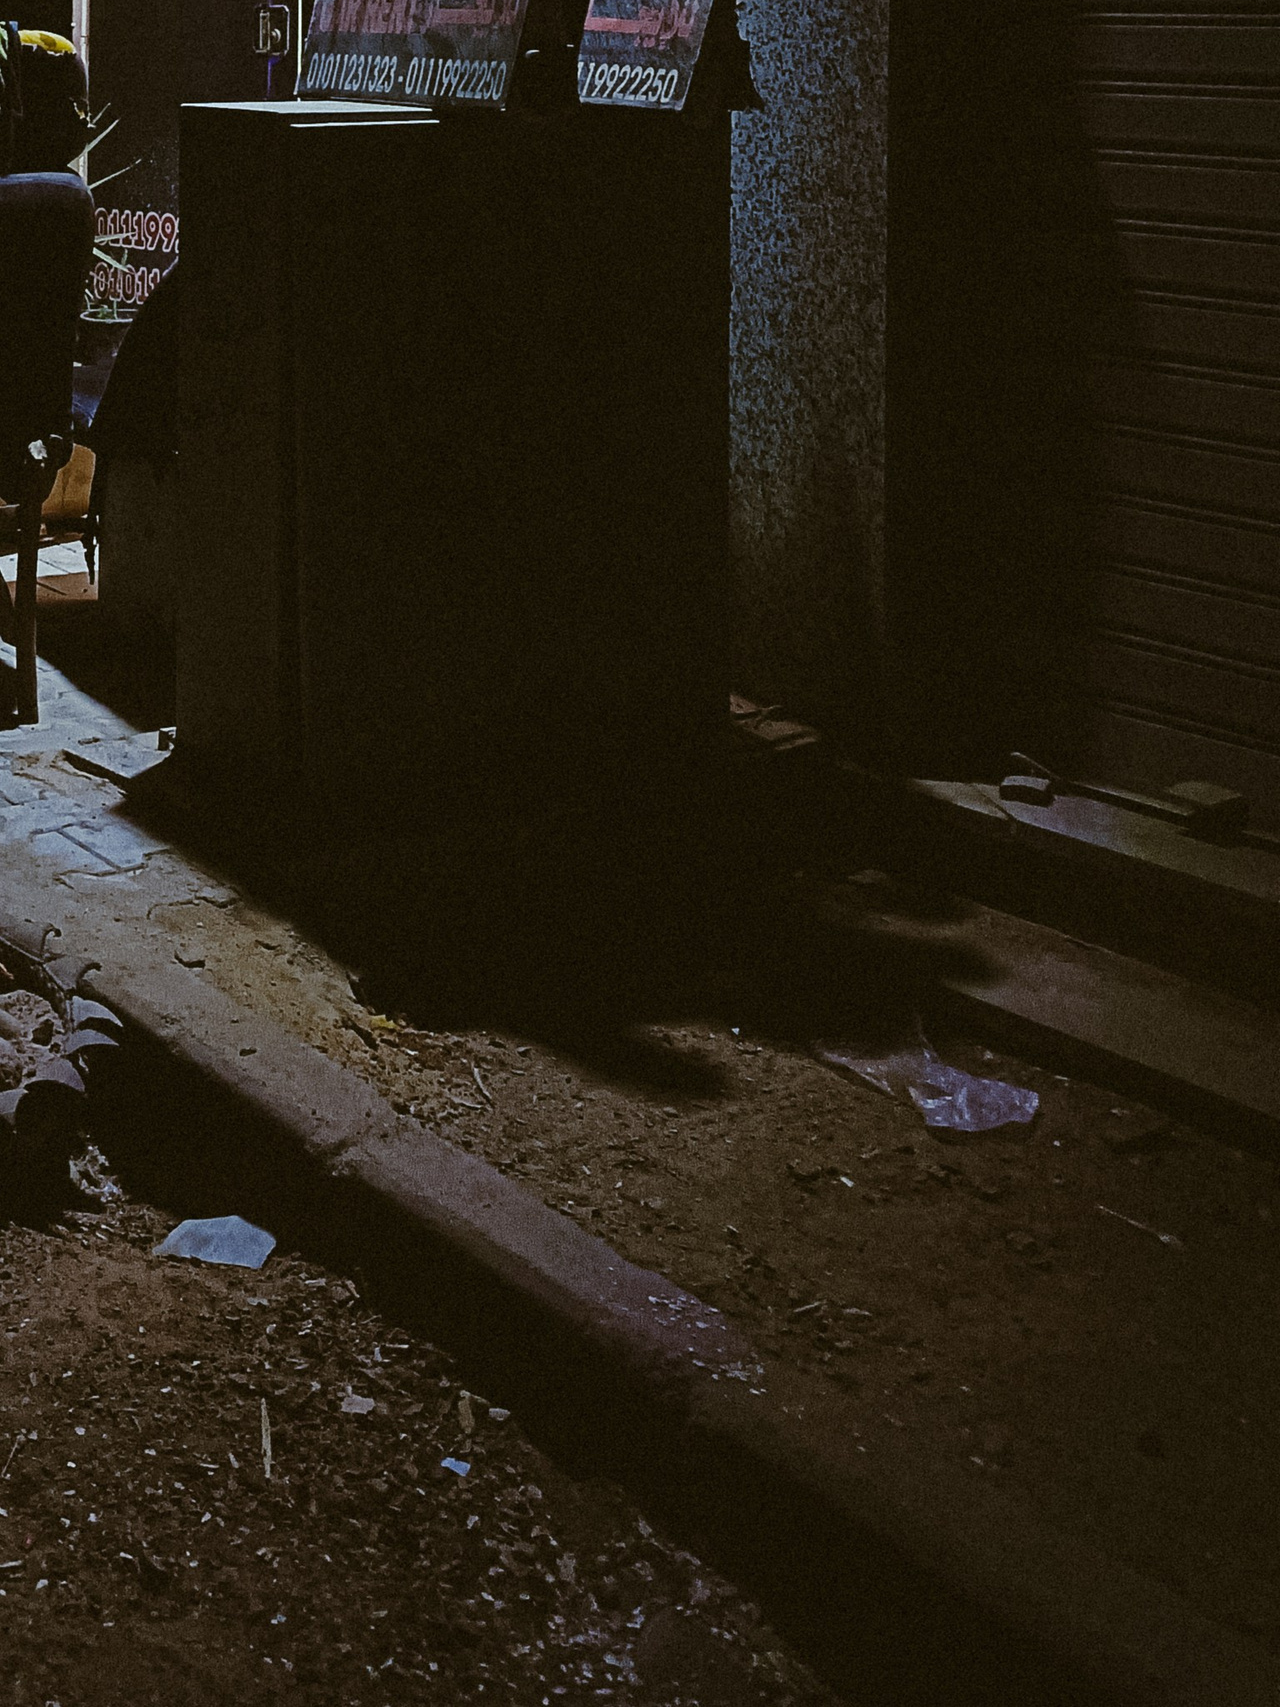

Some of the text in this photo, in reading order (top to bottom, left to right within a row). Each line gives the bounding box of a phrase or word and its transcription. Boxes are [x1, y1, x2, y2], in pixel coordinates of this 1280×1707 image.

[307, 53, 398, 93] 01011231323
[405, 56, 507, 100] 01119922250
[94, 207, 179, 253] 011199
